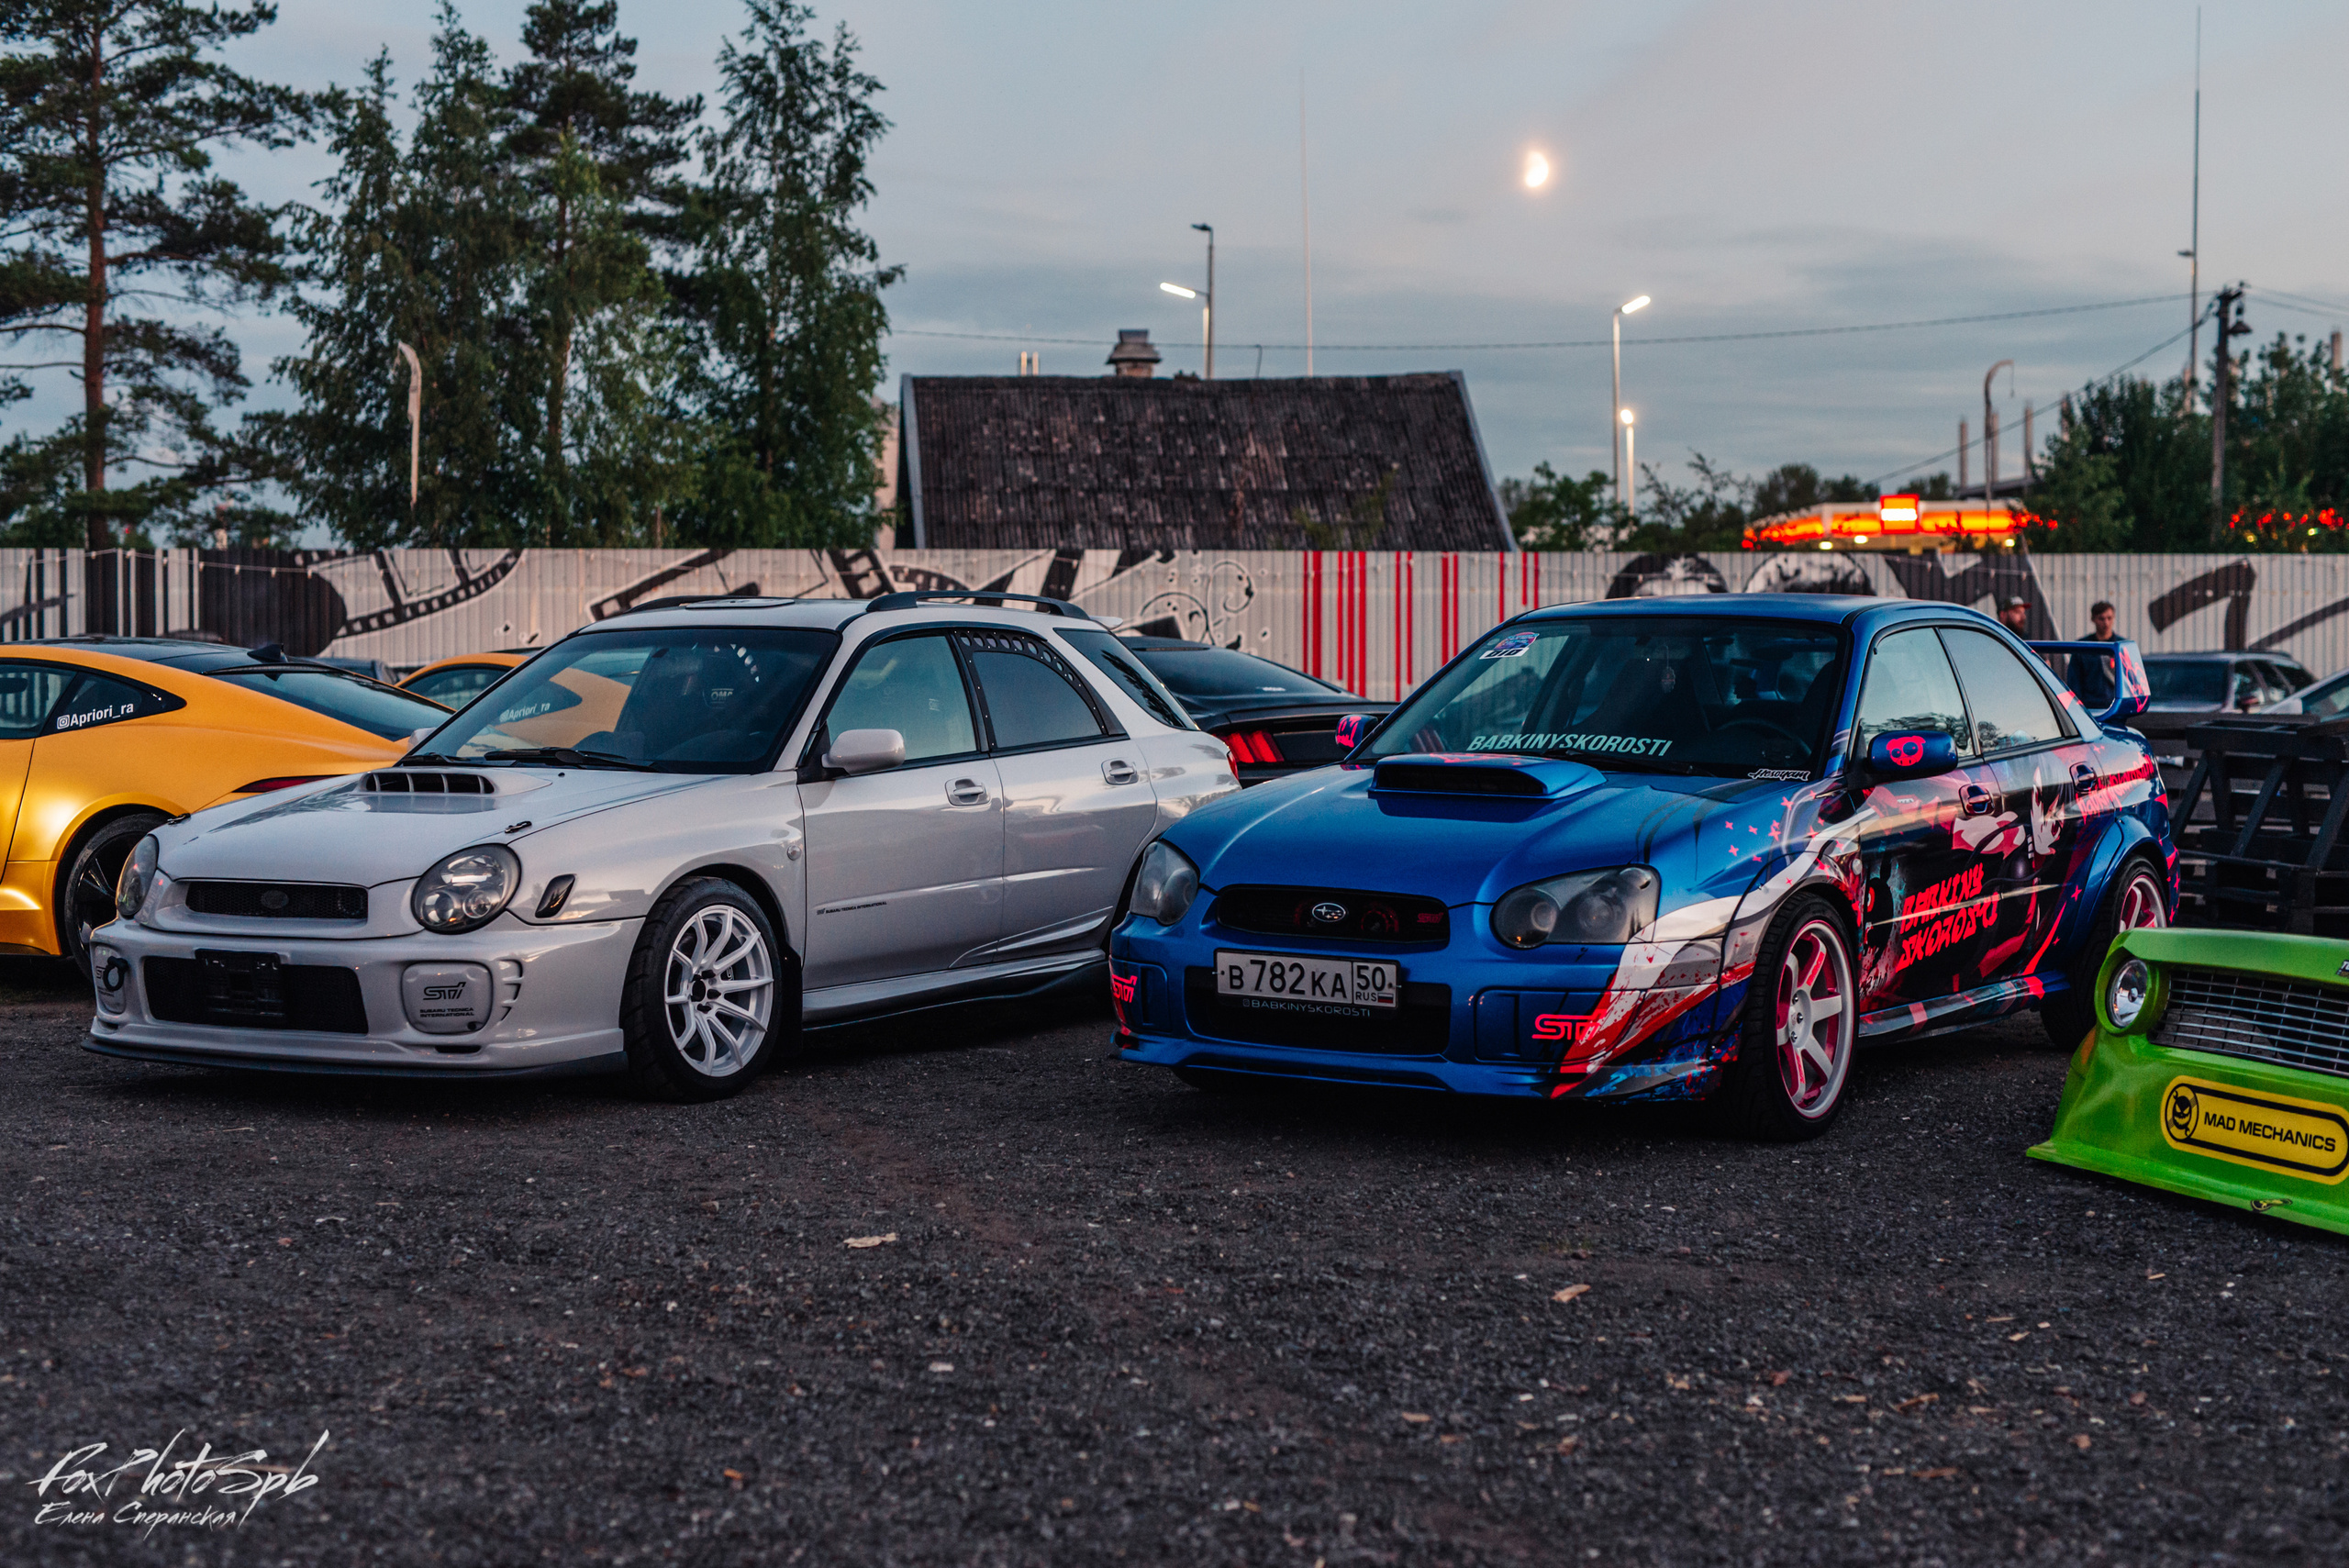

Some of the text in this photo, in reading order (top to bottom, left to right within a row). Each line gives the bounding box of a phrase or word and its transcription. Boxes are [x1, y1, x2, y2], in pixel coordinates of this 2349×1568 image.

[1466, 733, 1673, 757] BABKINYSKOROSTI
[1356, 964, 1386, 992] 50
[1355, 991, 1376, 1002] RUS
[2204, 1111, 2336, 1152] MAD MECHANICS
